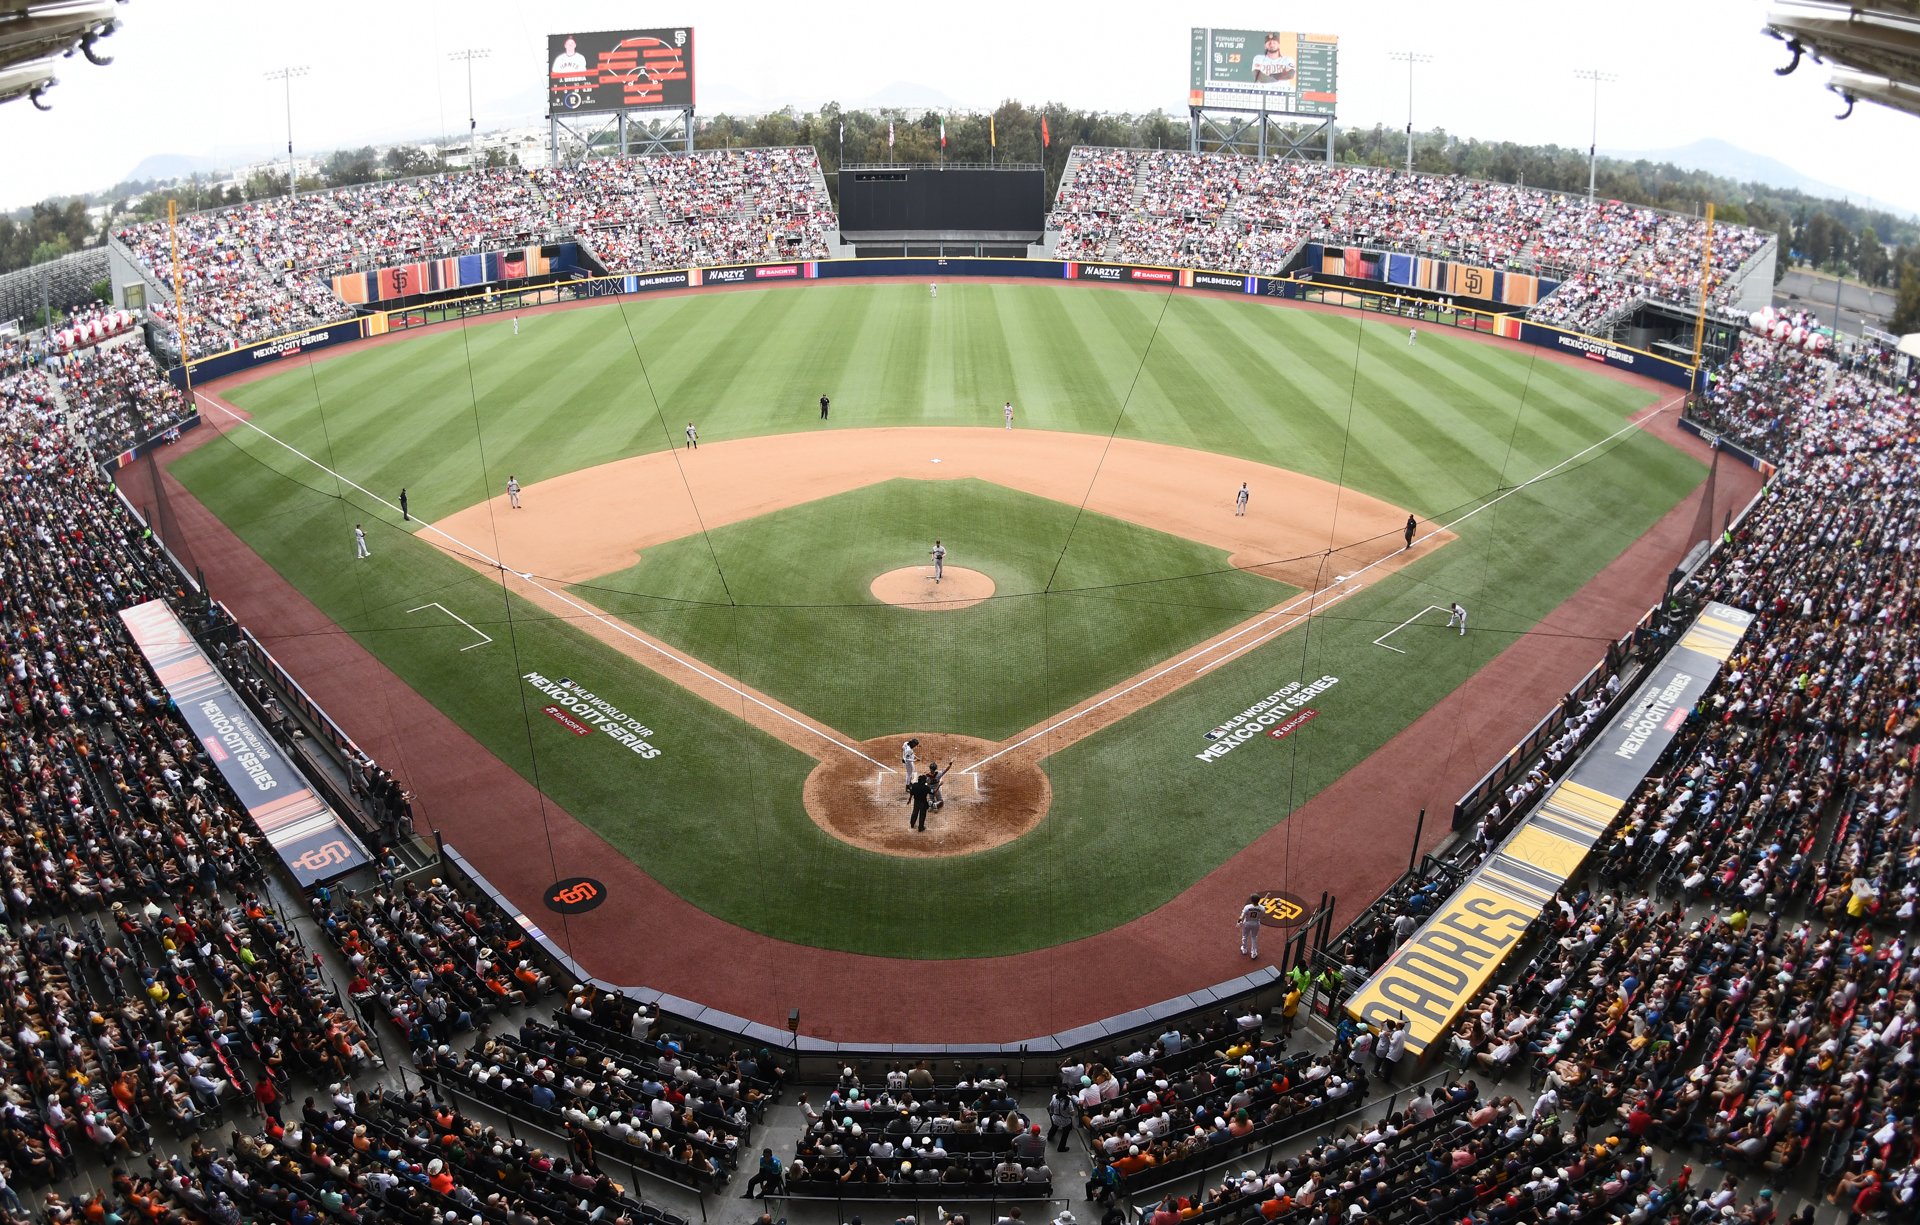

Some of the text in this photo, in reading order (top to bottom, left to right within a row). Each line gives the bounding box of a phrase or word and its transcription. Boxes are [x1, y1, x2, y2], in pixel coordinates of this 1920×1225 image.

[1229, 54, 1241, 63] 23
[392, 269, 408, 293] SF
[588, 277, 623, 297] MX
[640, 275, 685, 286] @MLBMEXICO
[1196, 276, 1242, 287] @MLBMEXICO
[1465, 268, 1483, 294] SD
[253, 332, 329, 359] MEXICO CITY SERIES
[1558, 336, 1634, 364] MEXICO CITY SERIES
[522, 671, 662, 760] MEXICO CITY SERIES
[570, 685, 654, 738] MLB WORLD TOUR
[1195, 675, 1339, 763] MEXICO CITY SERIES
[1219, 681, 1303, 732] MLB WORLD TOUR
[1614, 672, 1692, 760] MEXICO CITY SERIES
[554, 712, 588, 735] BANORTE
[1281, 709, 1315, 732] BANORTE
[199, 699, 278, 791] MEXICO CITY SERIES
[209, 741, 226, 760] BANORTE
[235, 719, 271, 760] MLB WORLD TOUR
[292, 841, 351, 870] SF
[553, 882, 597, 904] SF
[1360, 898, 1535, 1050] PADRES
[893, 1081, 902, 1089] 13
[1001, 1172, 1017, 1182] 28
